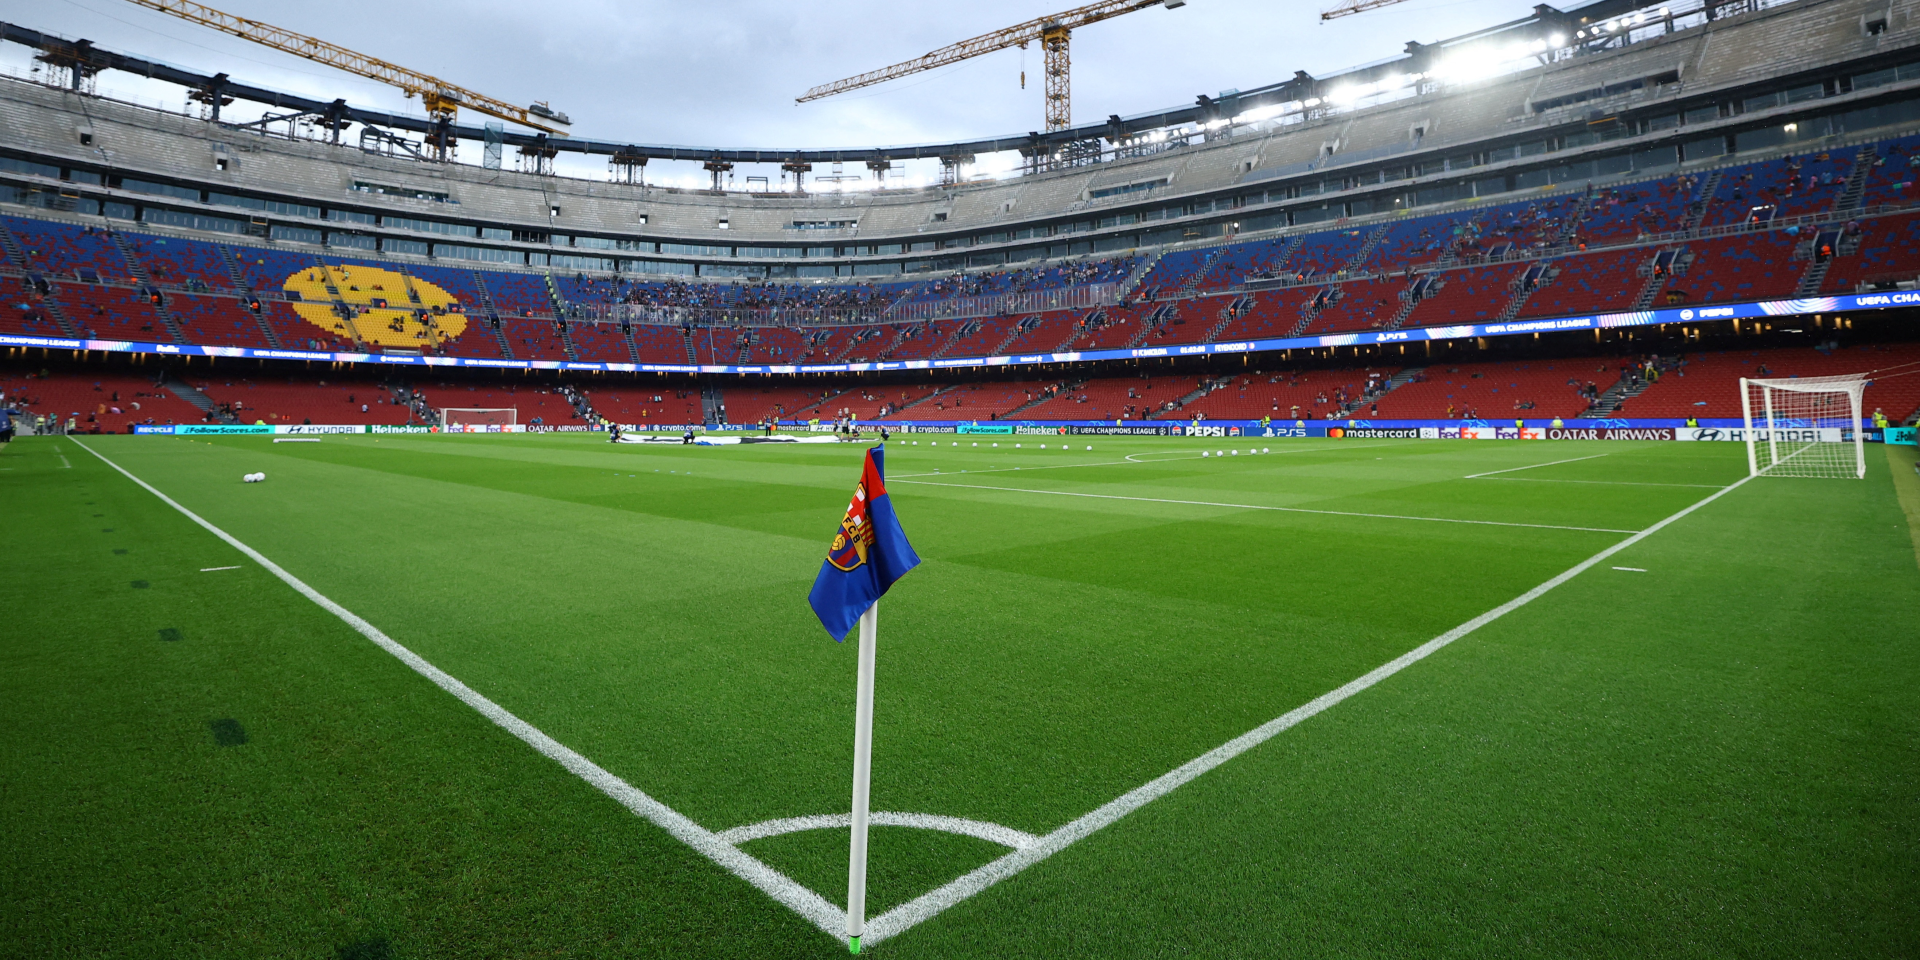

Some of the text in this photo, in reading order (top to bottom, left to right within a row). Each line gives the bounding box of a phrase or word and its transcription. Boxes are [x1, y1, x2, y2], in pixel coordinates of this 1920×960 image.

[1857, 295, 1890, 306] UEFA
[1485, 318, 1591, 334] UEFA CHAMPIONS LEAGUE
[49, 339, 80, 347] LEAGUE
[1215, 343, 1247, 352] FEYENOORD
[271, 350, 307, 359] CHAMPIONS
[307, 352, 330, 360] LEAGUE
[138, 425, 173, 433] RECYCLE
[308, 426, 356, 434] HYUNDAI
[372, 425, 427, 434] Heineken
[448, 424, 476, 433] FedEx
[486, 424, 513, 433] FedEx
[856, 425, 875, 433] QATAR
[918, 426, 955, 434] crypto.com
[1015, 426, 1058, 435] Heineken
[1097, 427, 1132, 435] CHAMPIONS
[1186, 426, 1225, 437] PEPSI
[1277, 428, 1307, 437] PS5
[1346, 428, 1417, 438] mastercard
[1439, 427, 1479, 440] FedEx
[1496, 427, 1539, 441] FedEx
[1549, 429, 1671, 441] QATAR AIRWAYS
